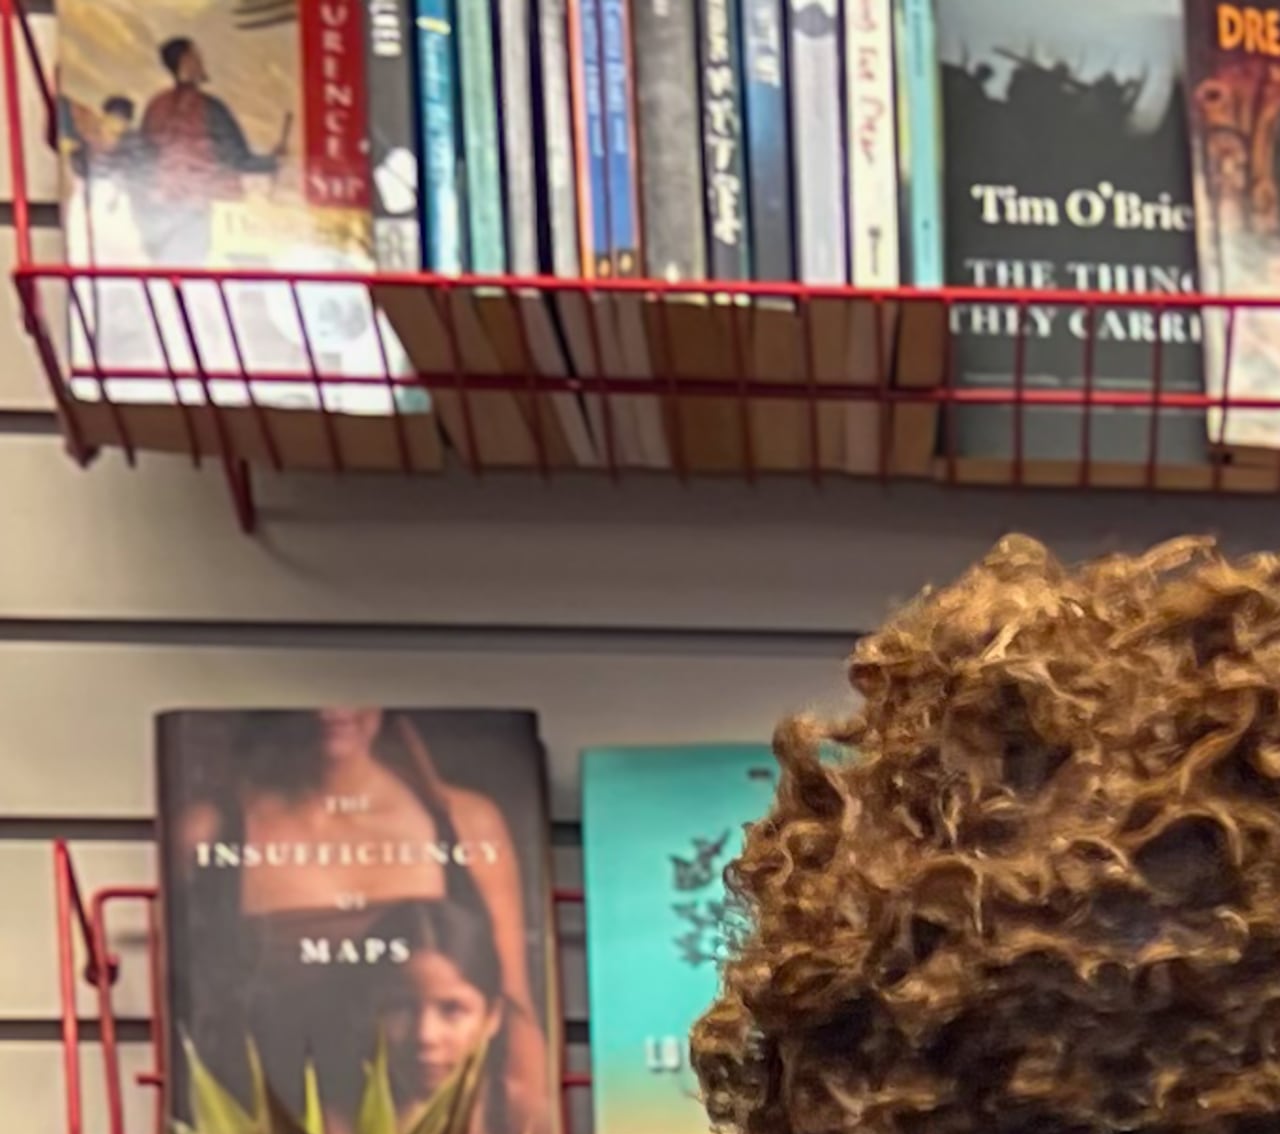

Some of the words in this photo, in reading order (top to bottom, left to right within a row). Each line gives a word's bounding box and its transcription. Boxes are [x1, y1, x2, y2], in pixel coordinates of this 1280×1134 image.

[970, 183, 1060, 226] Tim
[963, 258, 1055, 288] THE
[327, 796, 372, 814] THE
[195, 841, 502, 868] INSUFFICIENCY
[299, 937, 411, 965] MAPS
